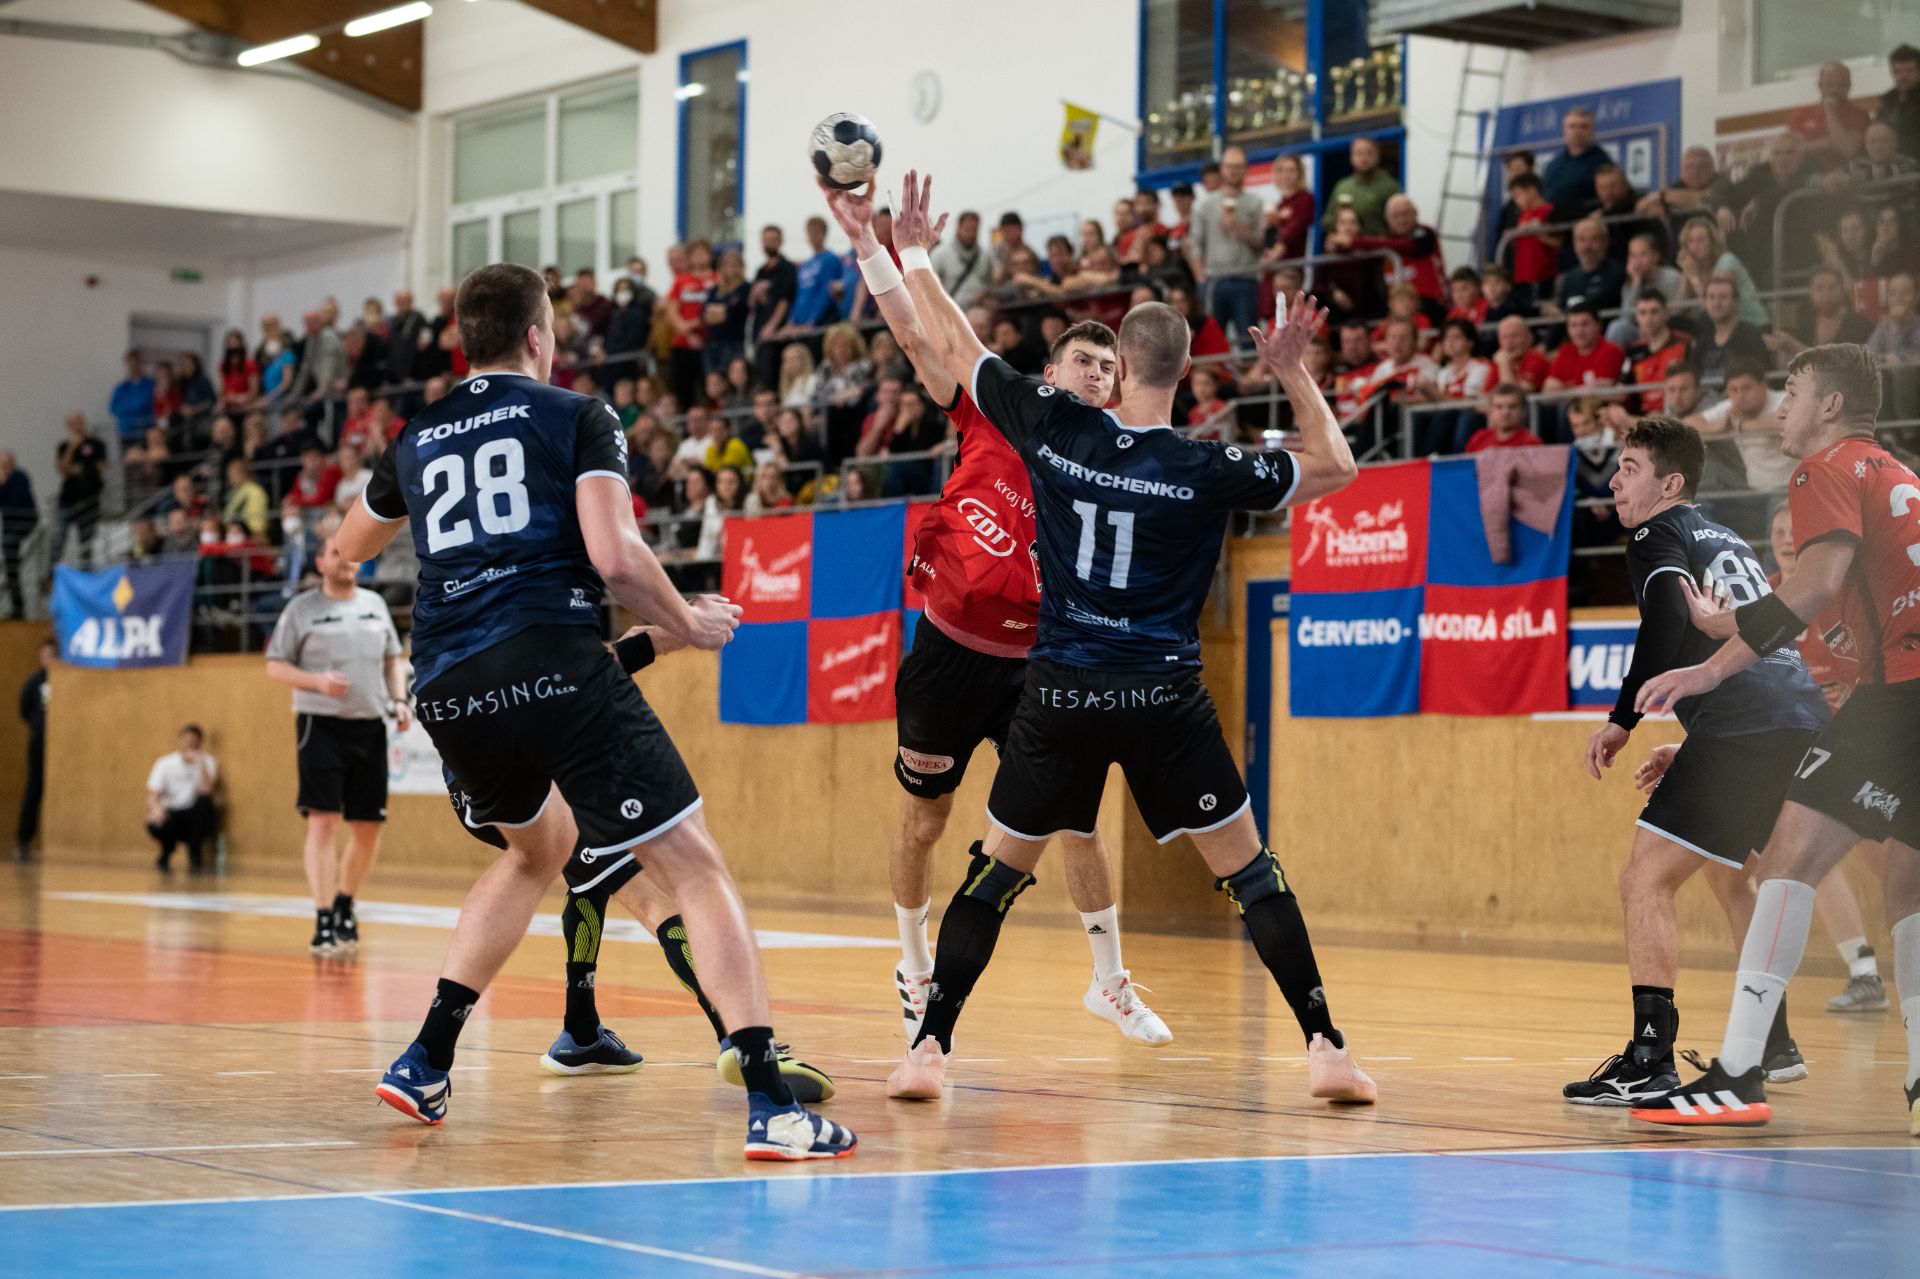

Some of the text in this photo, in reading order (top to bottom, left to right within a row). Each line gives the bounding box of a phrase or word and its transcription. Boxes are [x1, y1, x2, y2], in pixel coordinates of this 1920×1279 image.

[416, 404, 531, 447] ZOUREK
[1037, 443, 1195, 501] PETRYCHENKO
[422, 437, 531, 554] 28
[994, 478, 1020, 508] Kraj
[966, 507, 1011, 545] ZDT
[1072, 499, 1135, 589] 11
[1502, 606, 1558, 641] SÍLA
[421, 676, 554, 721] TESASING
[1039, 686, 1164, 711] TESASING
[902, 750, 947, 769] ENPEKA
